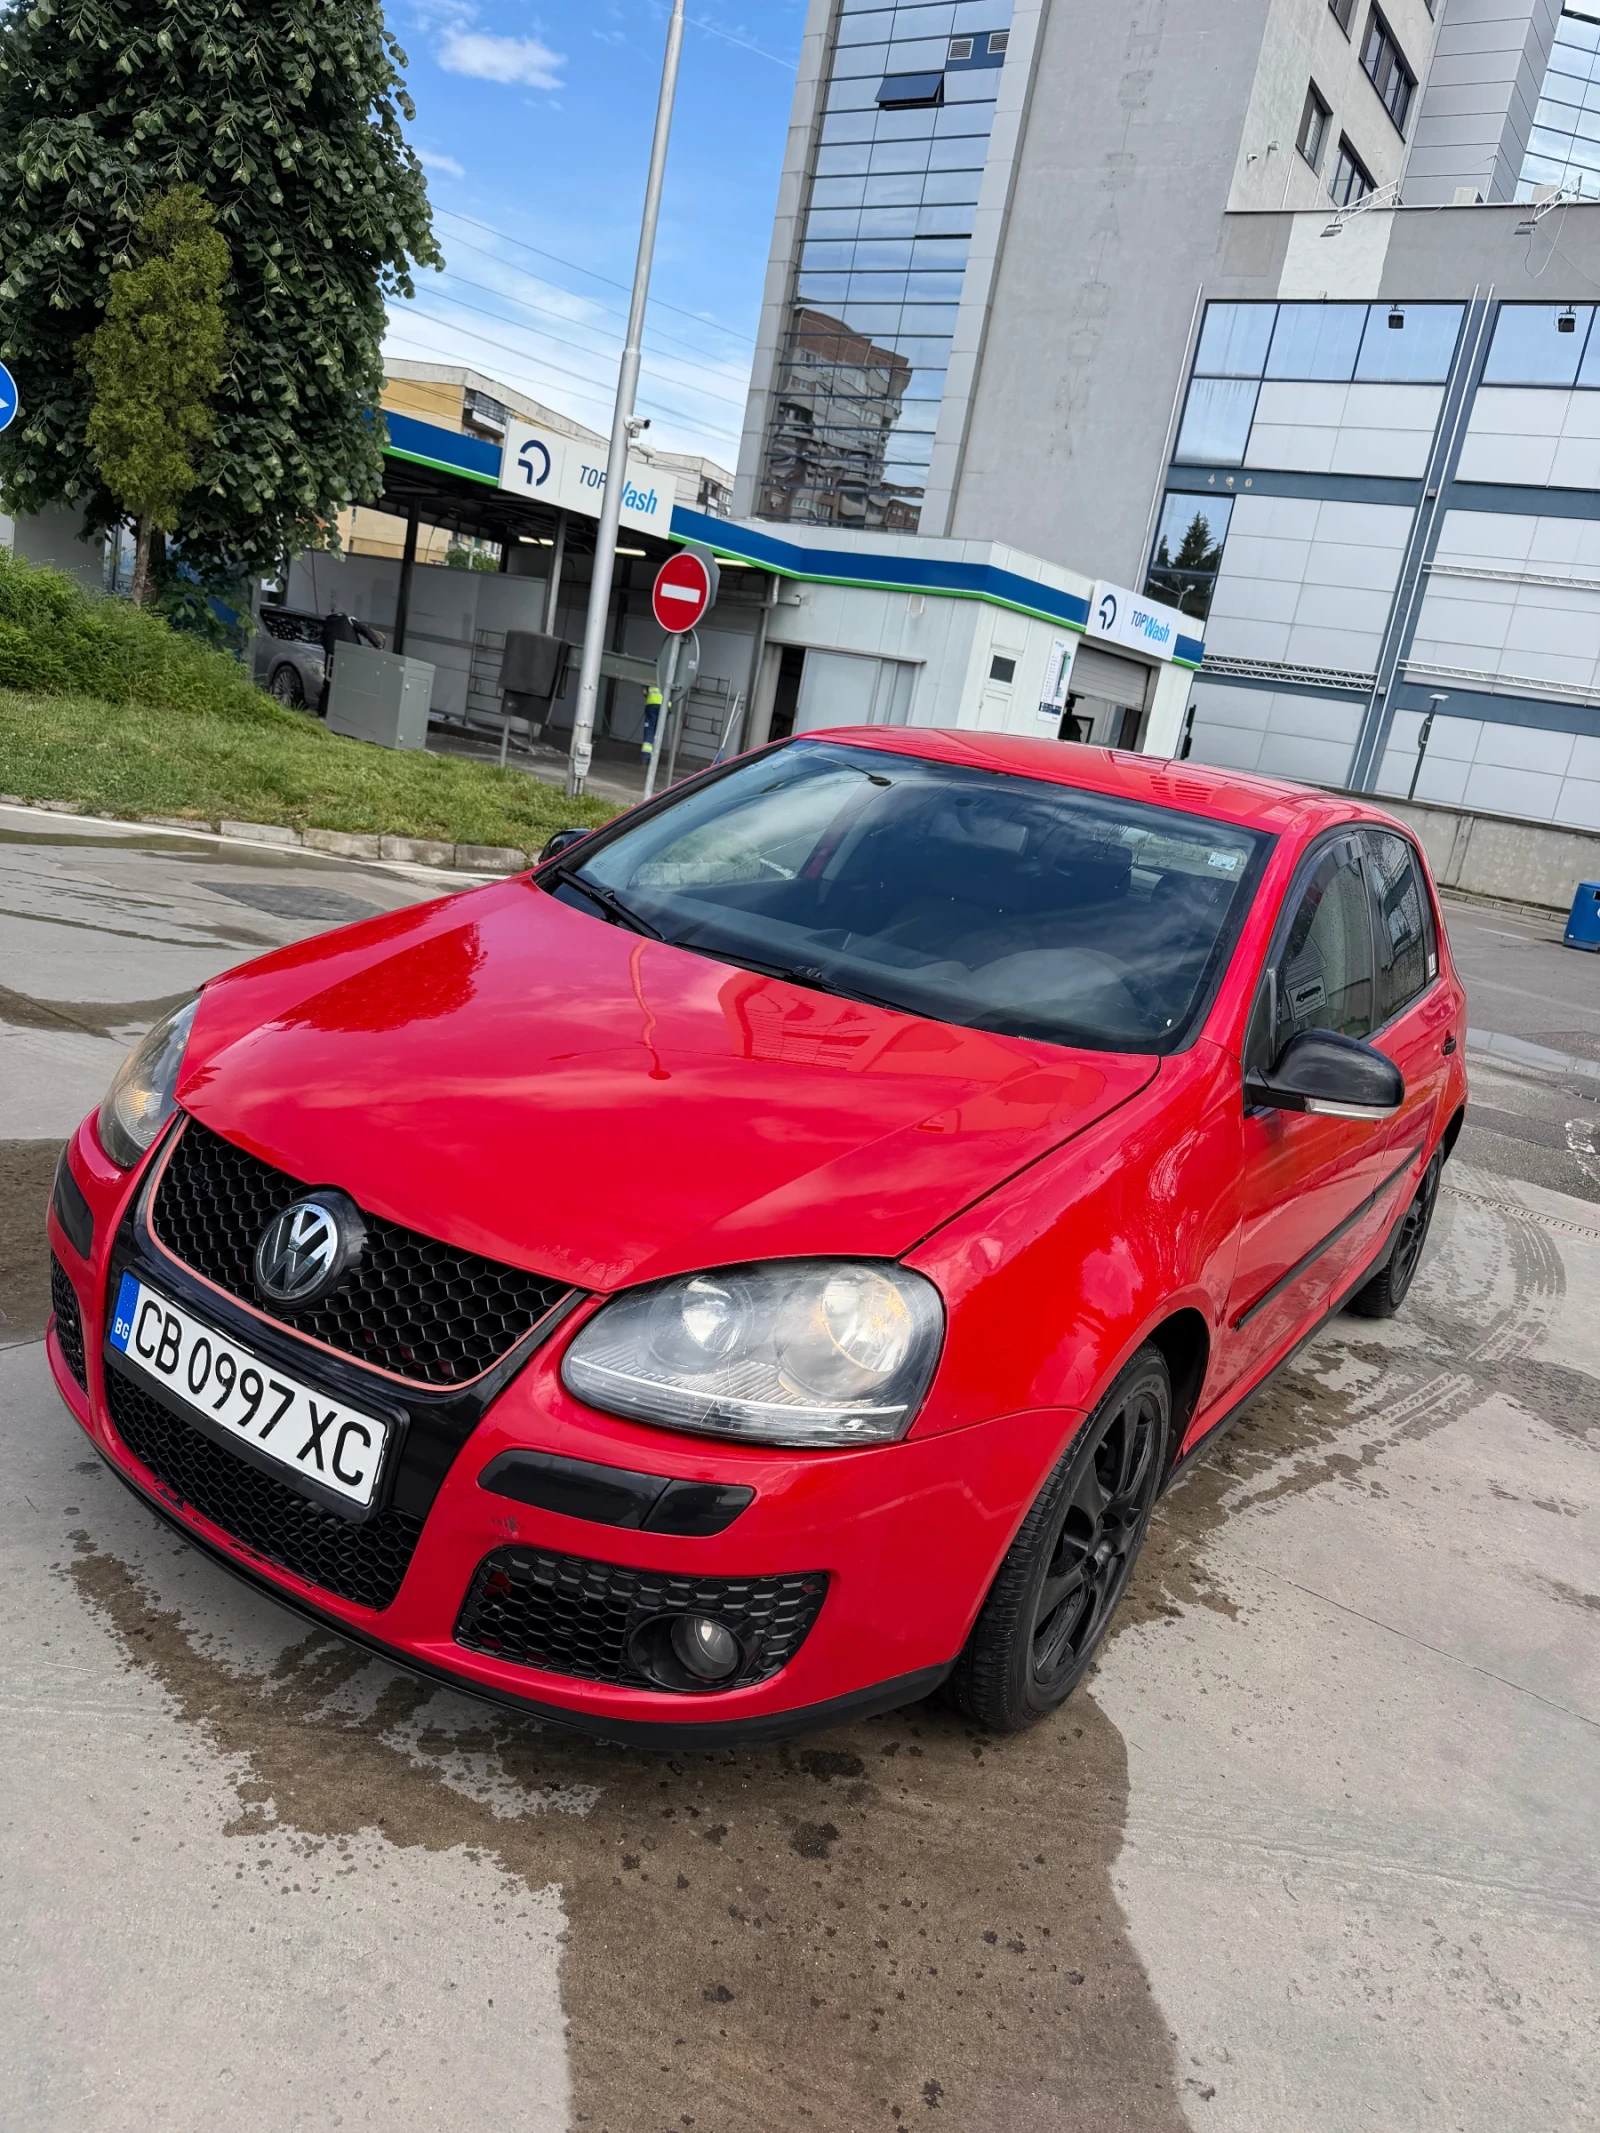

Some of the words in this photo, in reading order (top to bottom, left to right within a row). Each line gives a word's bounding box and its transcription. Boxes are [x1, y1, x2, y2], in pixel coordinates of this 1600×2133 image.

[114, 1317, 130, 1340] BG
[136, 1300, 182, 1374] CB
[188, 1337, 295, 1439] 0997
[297, 1400, 371, 1486] XC
